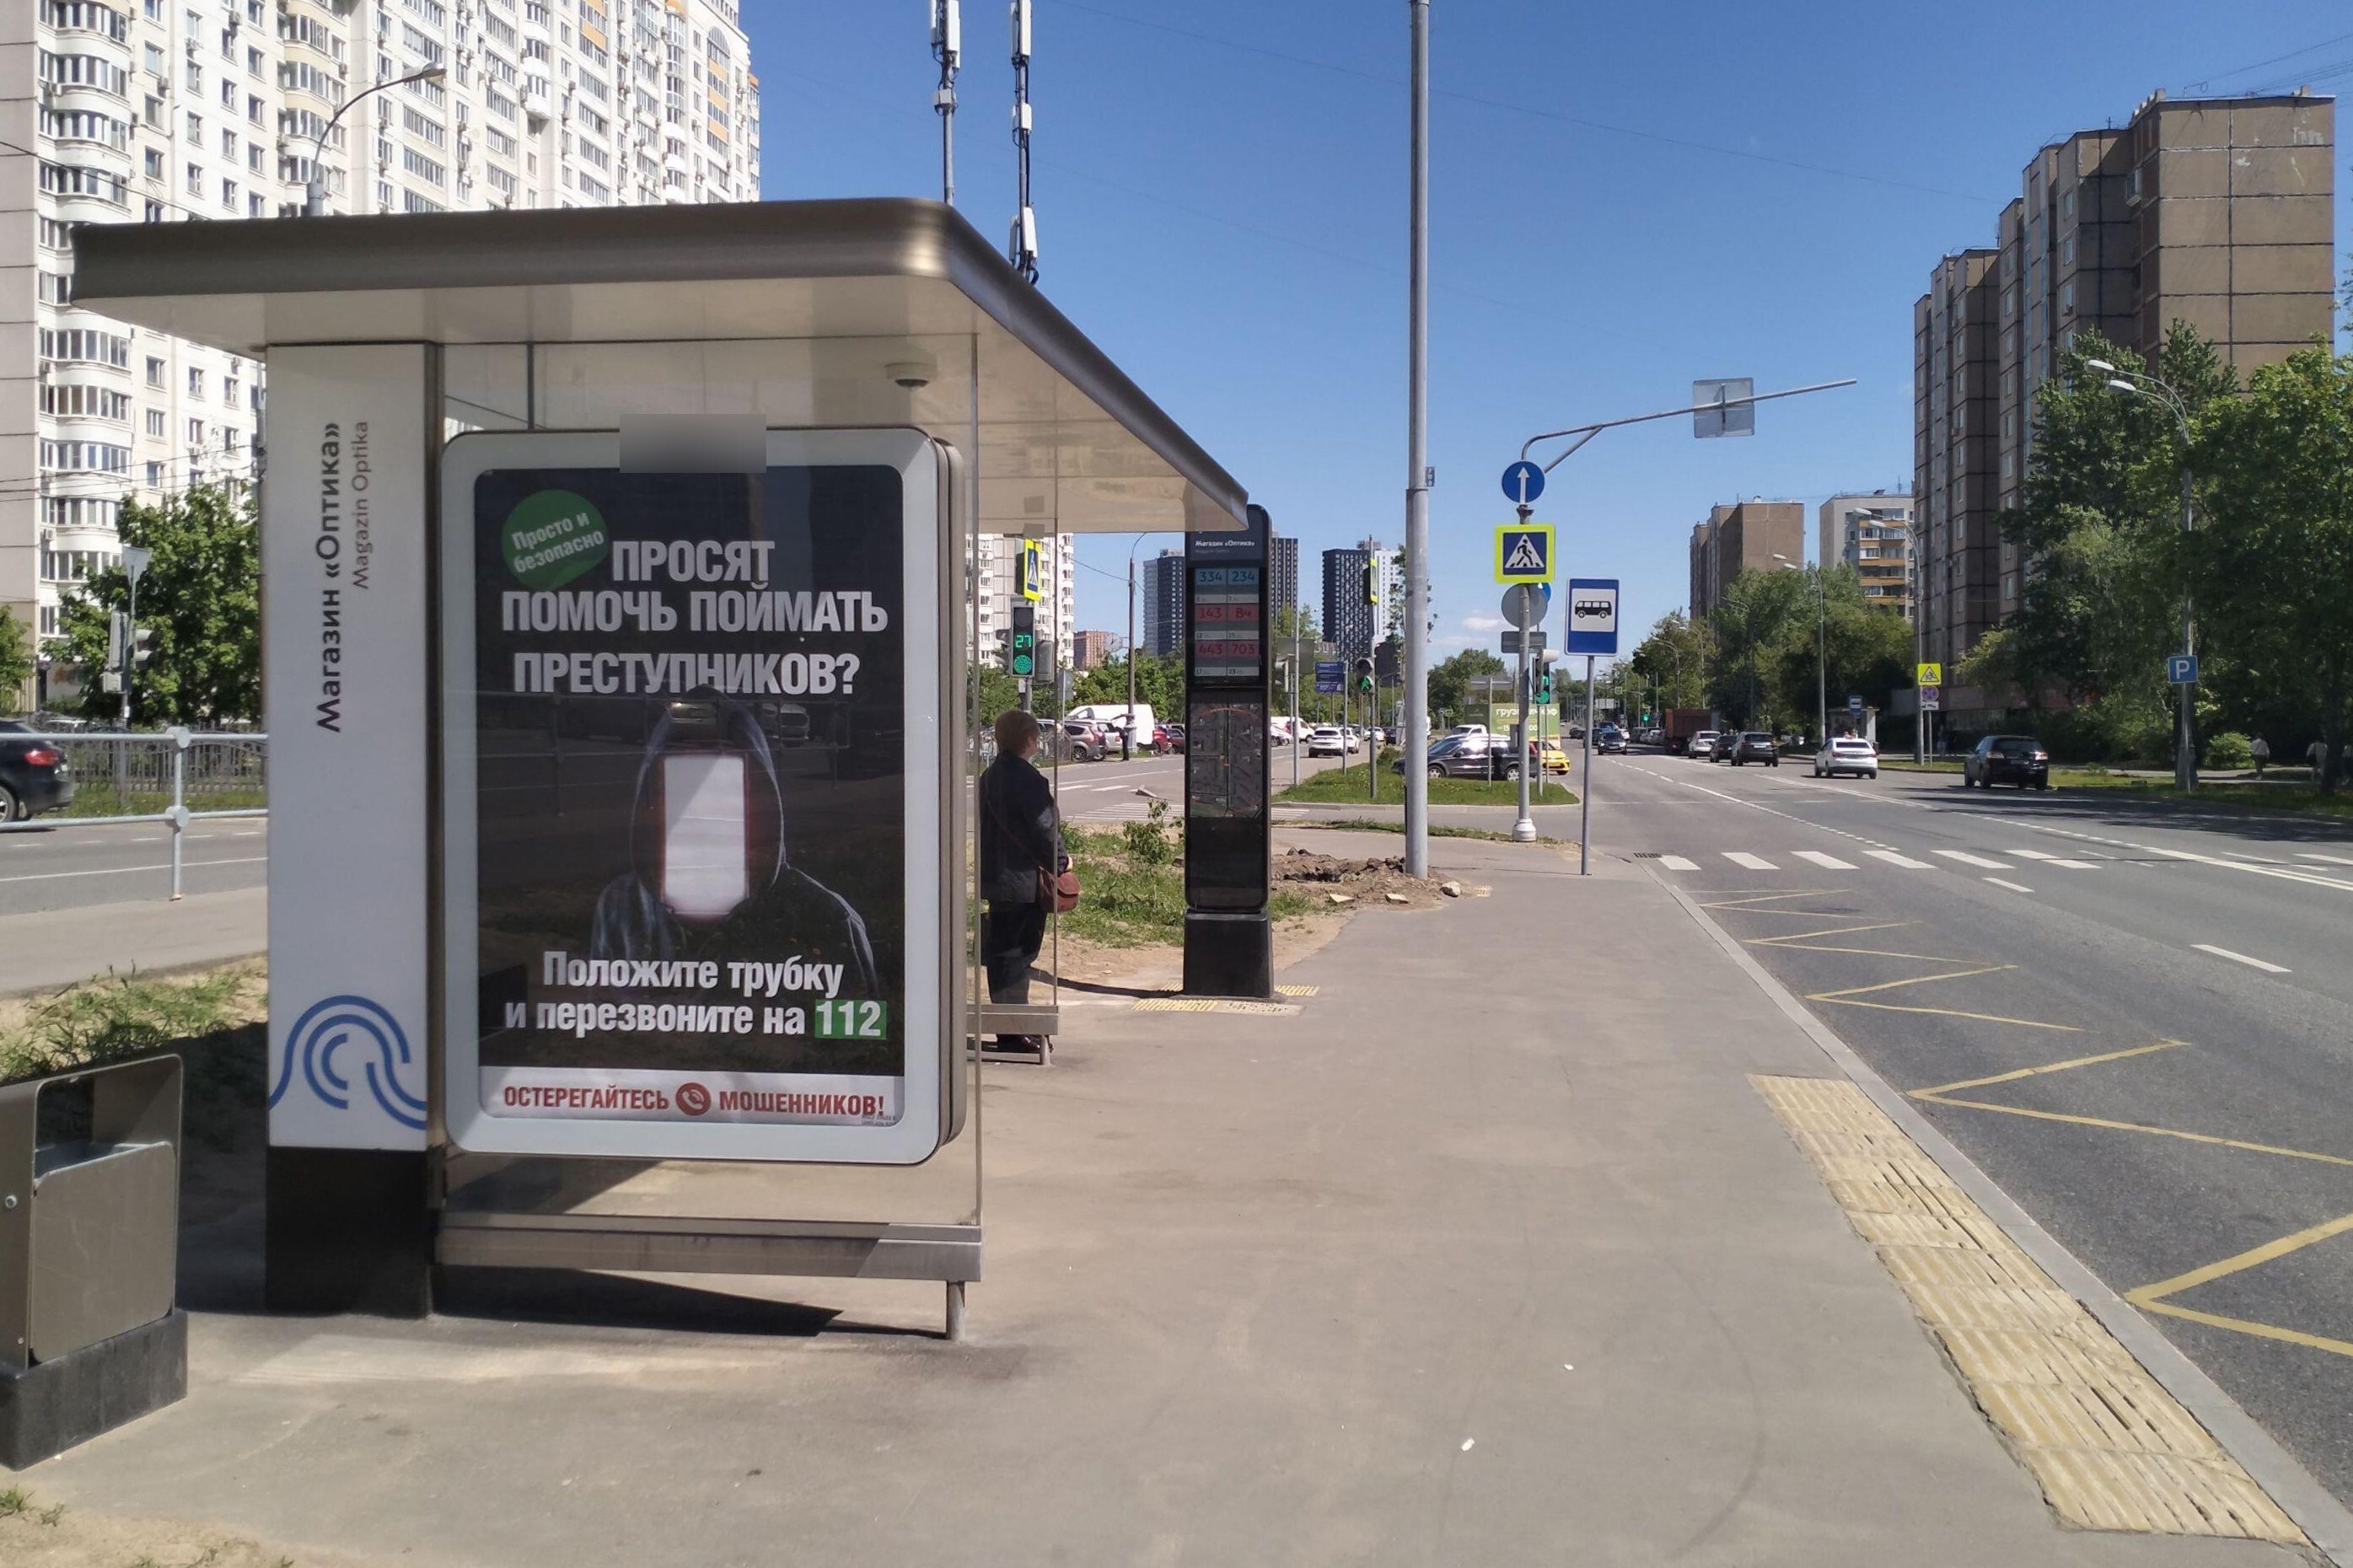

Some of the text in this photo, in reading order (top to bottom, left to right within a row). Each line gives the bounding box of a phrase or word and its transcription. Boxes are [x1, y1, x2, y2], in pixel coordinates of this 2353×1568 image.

[350, 422, 373, 589] Magazin Optika
[512, 513, 590, 551] Просто и
[513, 529, 605, 575] безопасно
[314, 422, 341, 733] Магазин «Оптика»
[612, 540, 776, 583] ПРОСЯТ
[1199, 571, 1222, 583] 334
[1232, 571, 1255, 583] 234
[502, 582, 889, 633] ПОМОЧЬ ПОЙМАТЬ
[1015, 635, 1032, 648] 27
[513, 652, 861, 695] ПРЕСТУПНИКОВ?
[2175, 660, 2190, 679] P
[543, 950, 845, 998] Положите трубку
[504, 1000, 883, 1039] и перезвоните на 112
[503, 1083, 886, 1117] ОСТЕРЕГАЙТЕСЬ МОШЕННИКОВ!
